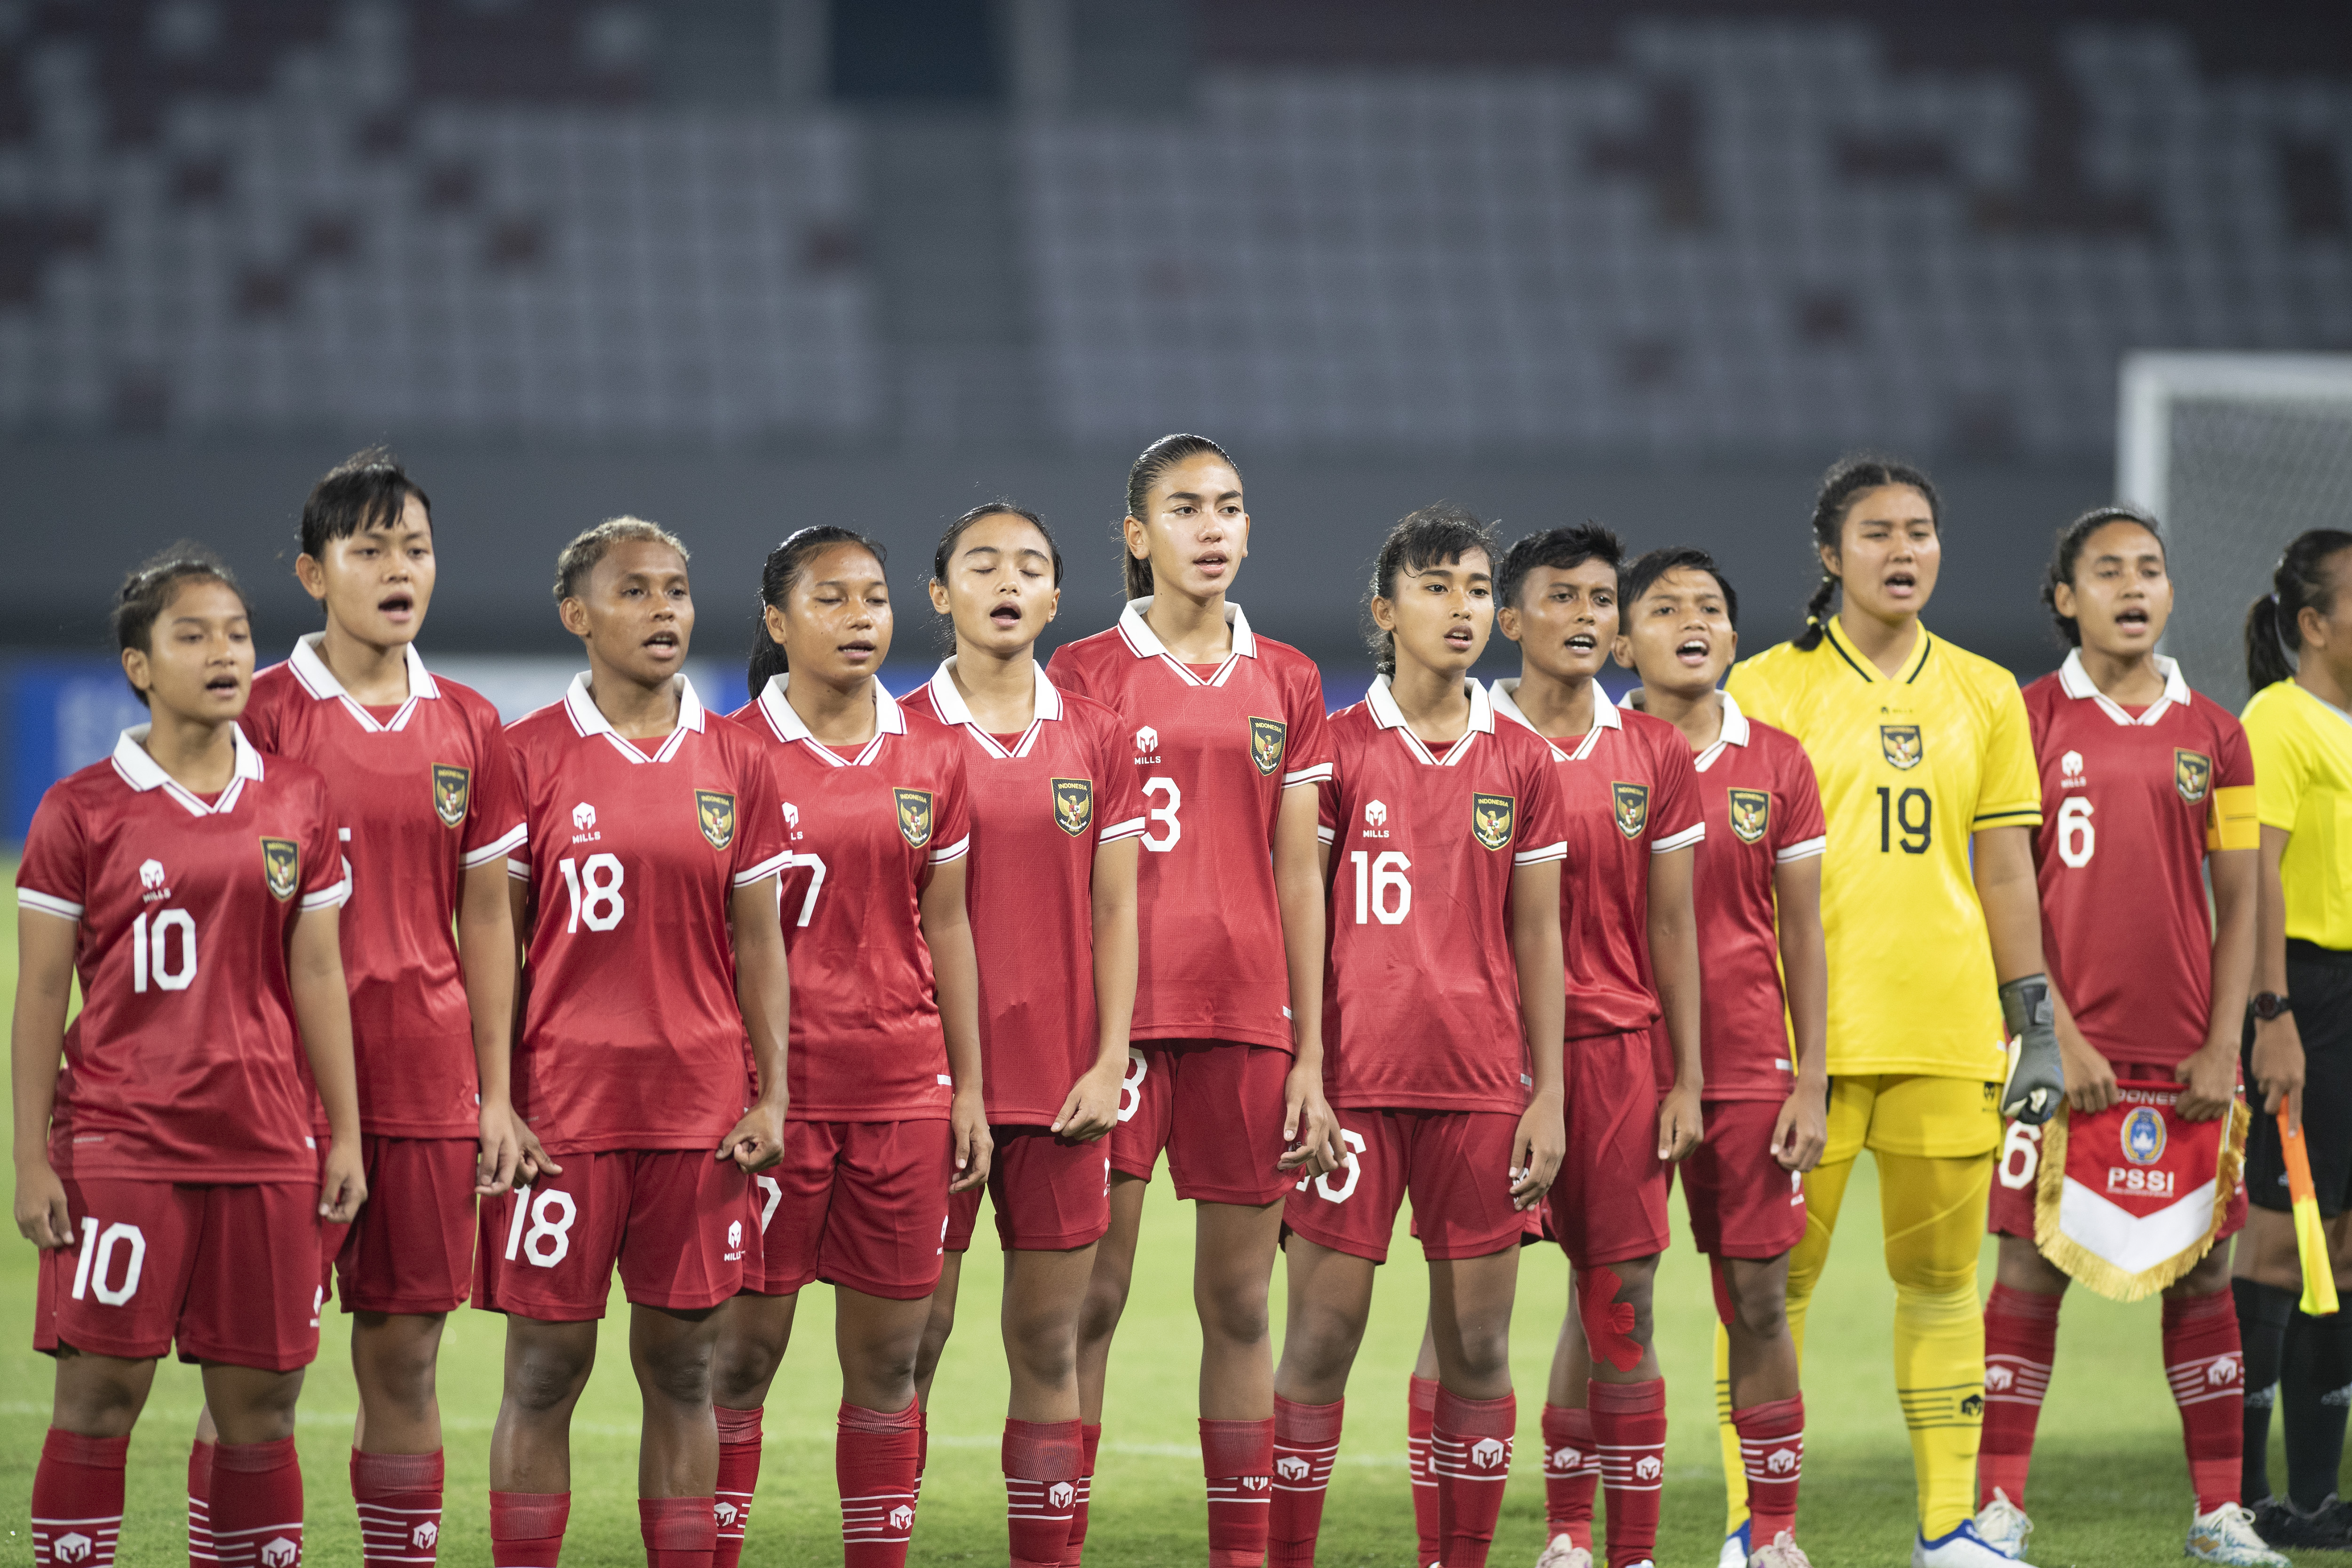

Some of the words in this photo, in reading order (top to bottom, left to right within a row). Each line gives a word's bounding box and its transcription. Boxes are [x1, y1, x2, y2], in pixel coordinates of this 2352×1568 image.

[1134, 756, 1161, 765] MILLS
[1255, 722, 1282, 733] INDONESIA
[700, 795, 730, 807] INDONESIA
[899, 793, 927, 808] INDONESIA
[1057, 783, 1087, 791] INDONESIA
[1141, 777, 1181, 852] 3
[1478, 798, 1509, 808] INDONESIA
[1877, 787, 1931, 854] 19
[572, 831, 601, 844] MILLS
[2058, 796, 2095, 868] 6
[142, 887, 172, 904] MILLS
[560, 853, 624, 934] 18
[777, 853, 826, 926] 7
[1351, 851, 1412, 925] 16
[134, 908, 197, 993] 10
[1295, 1128, 1367, 1204] 6
[1998, 1119, 2042, 1190] 6
[2108, 1167, 2174, 1192] PSSI
[505, 1184, 577, 1268] 18
[72, 1217, 146, 1306] 10
